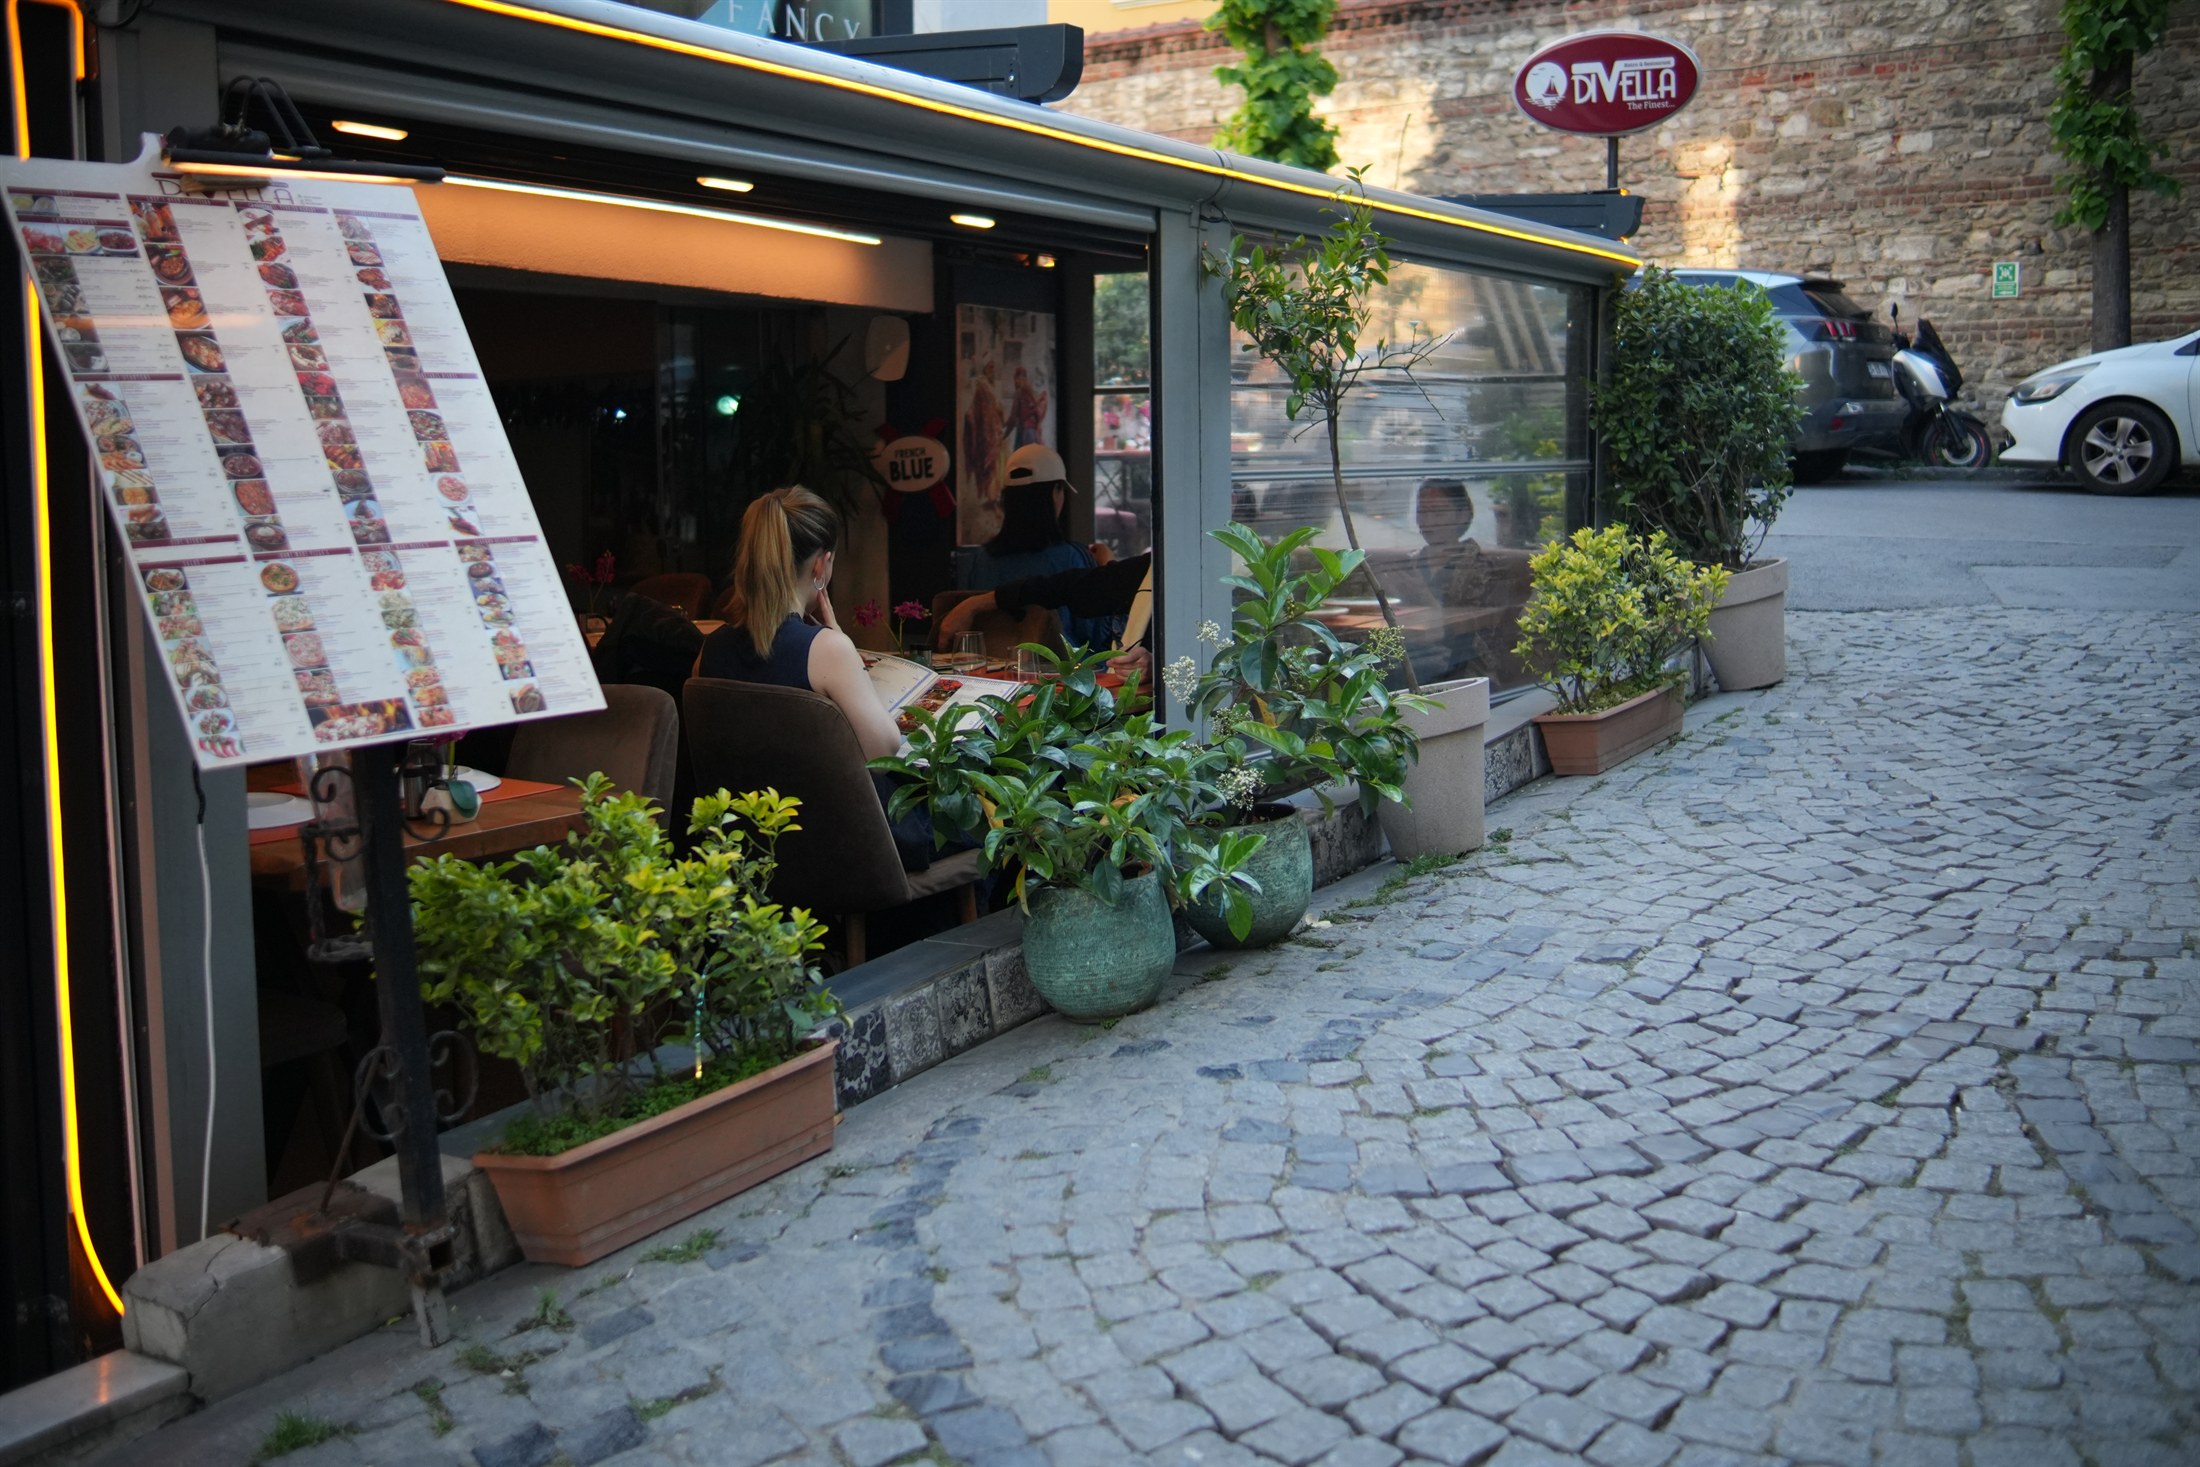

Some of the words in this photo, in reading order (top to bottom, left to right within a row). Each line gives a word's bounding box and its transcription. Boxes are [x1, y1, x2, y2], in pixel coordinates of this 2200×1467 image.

[729, 0, 860, 42] FANCY
[1627, 102, 1642, 110] The
[895, 448, 926, 458] FRENCH
[889, 457, 934, 482] BLUE
